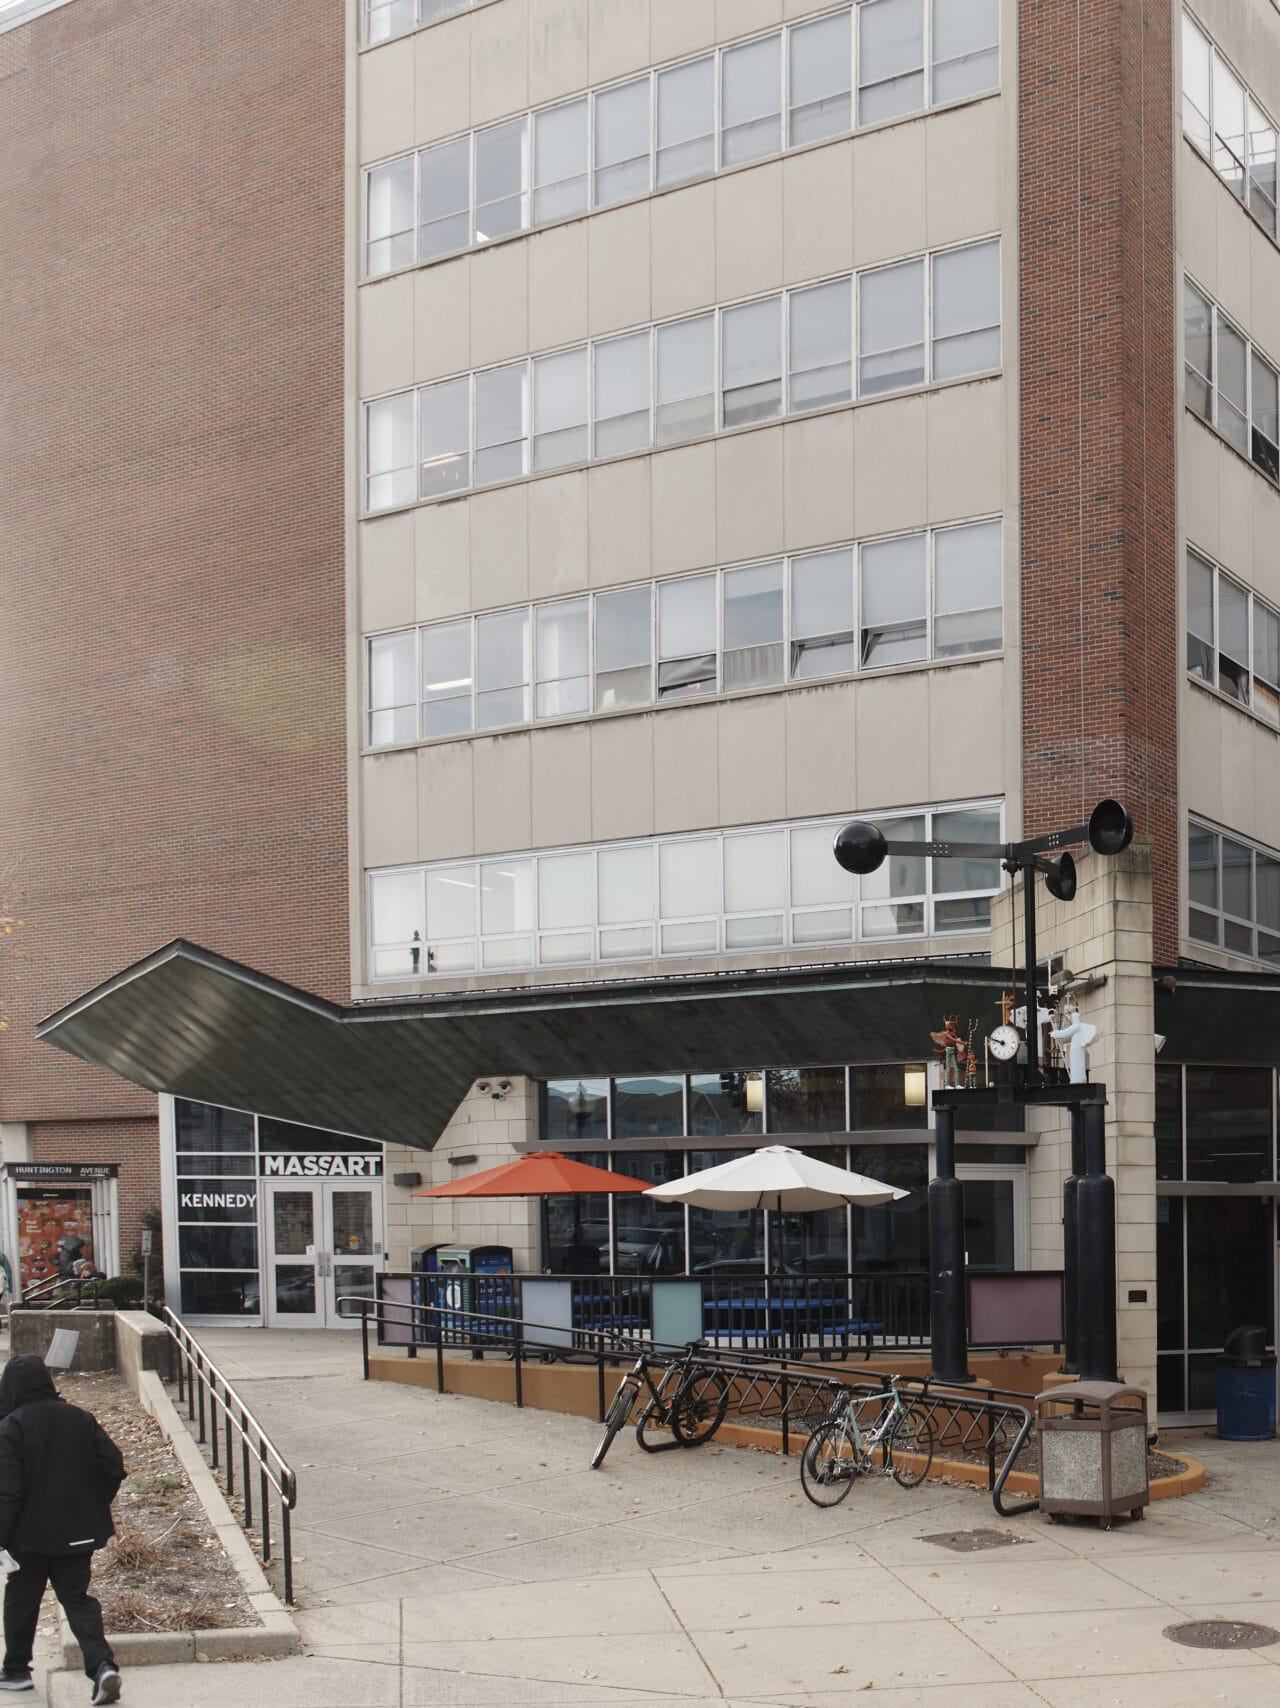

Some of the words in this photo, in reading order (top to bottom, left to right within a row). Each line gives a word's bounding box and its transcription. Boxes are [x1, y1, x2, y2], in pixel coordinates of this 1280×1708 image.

[15, 1166, 72, 1174] HUNTINGTON
[80, 1167, 111, 1175] AVENUE
[265, 1156, 381, 1176] MASSART
[181, 1193, 257, 1208] KENNEDY
